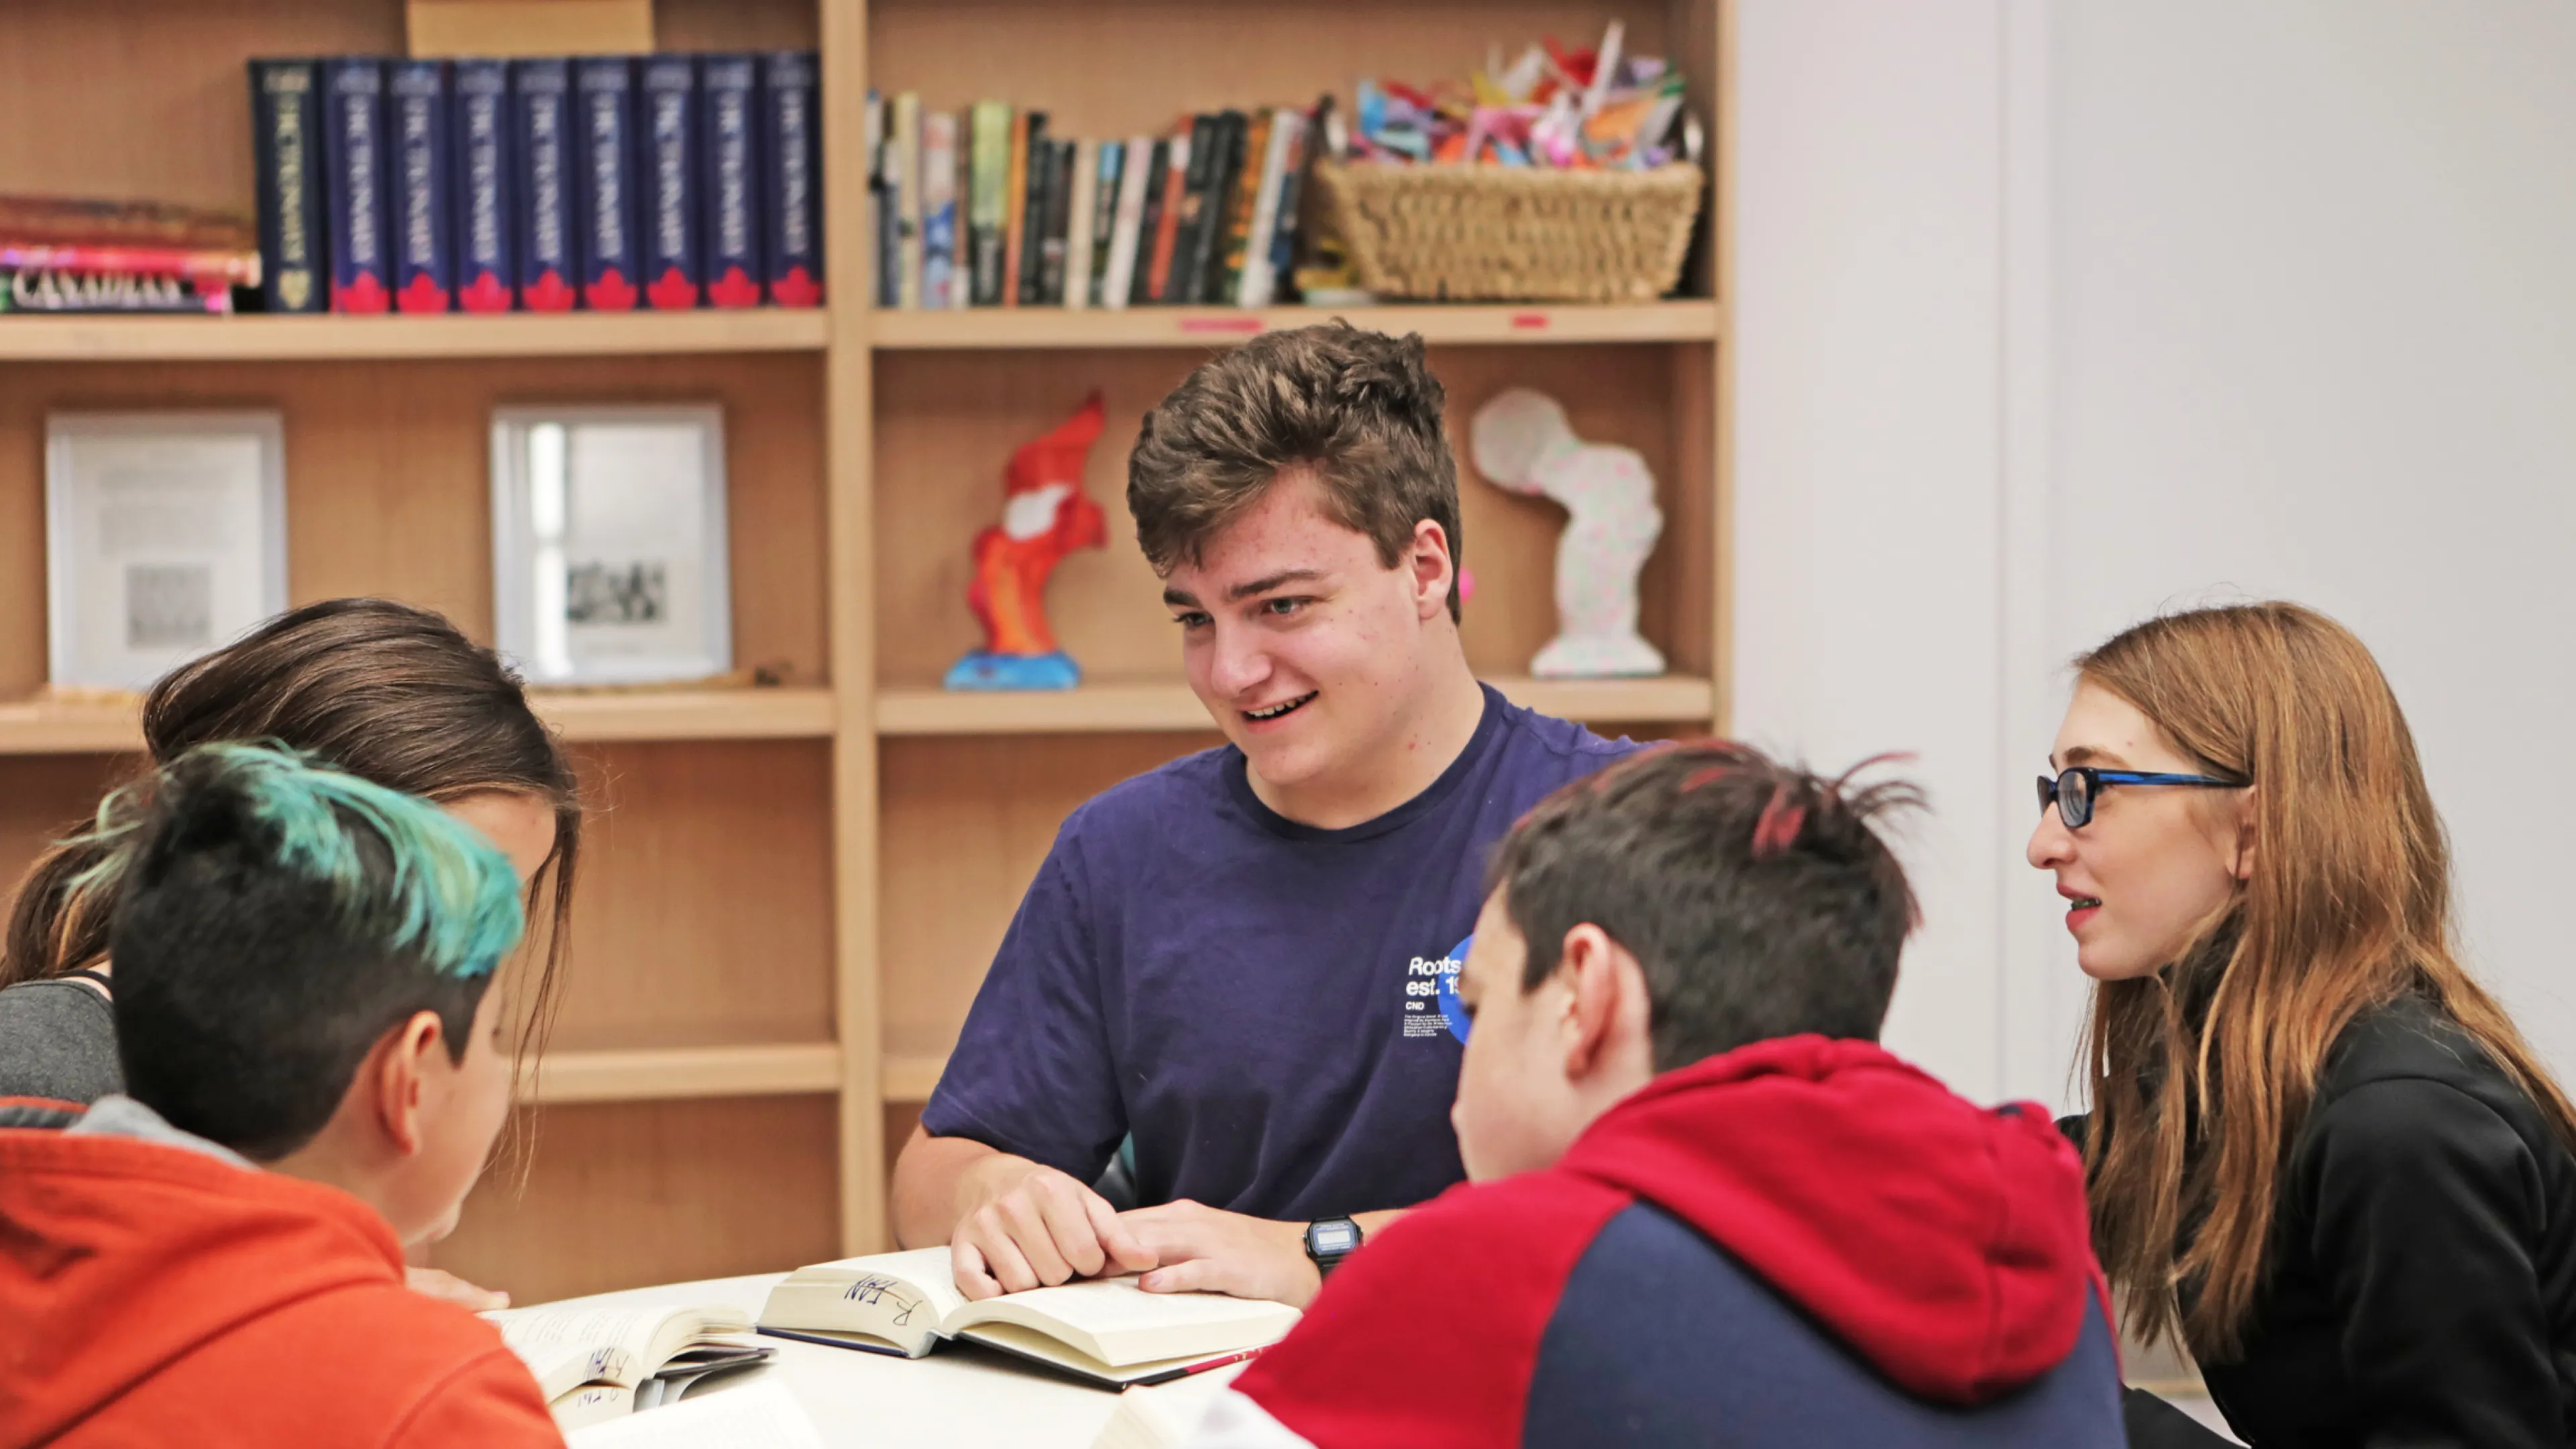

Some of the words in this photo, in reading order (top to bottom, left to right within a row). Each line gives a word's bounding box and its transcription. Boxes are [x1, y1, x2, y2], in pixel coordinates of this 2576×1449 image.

[1409, 957, 1461, 975] Roots
[1406, 978, 1440, 996] est.
[1405, 1002, 1425, 1011] CND
